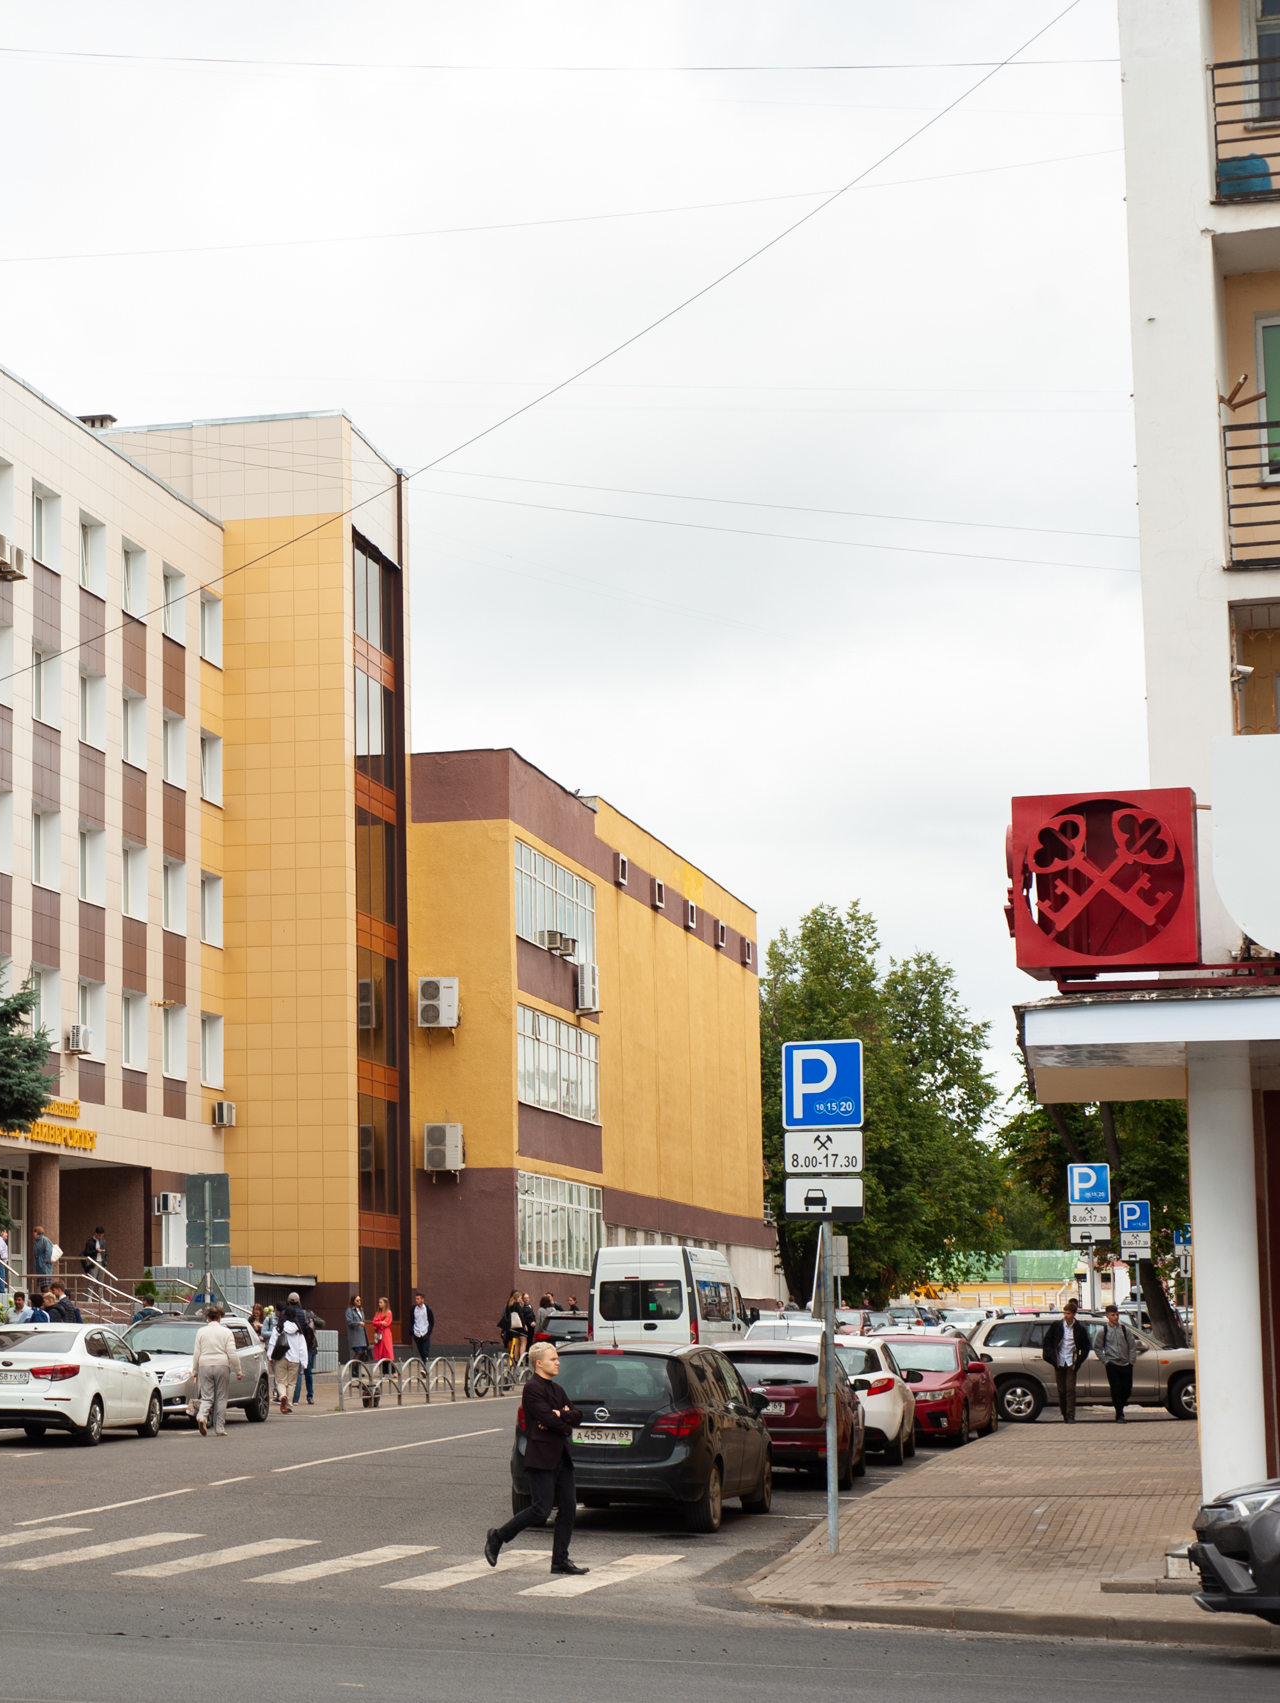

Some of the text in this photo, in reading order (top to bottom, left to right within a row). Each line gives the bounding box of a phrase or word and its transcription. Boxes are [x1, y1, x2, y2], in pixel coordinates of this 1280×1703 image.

[793, 1049, 837, 1119] P
[815, 1101, 853, 1112] 10 15 20
[791, 1153, 858, 1168] 8.00-17.30
[1073, 1167, 1097, 1200] P
[1072, 1214, 1108, 1222] 8.00-17.30
[1123, 1204, 1141, 1229] P
[618, 1430, 630, 1438] 69
